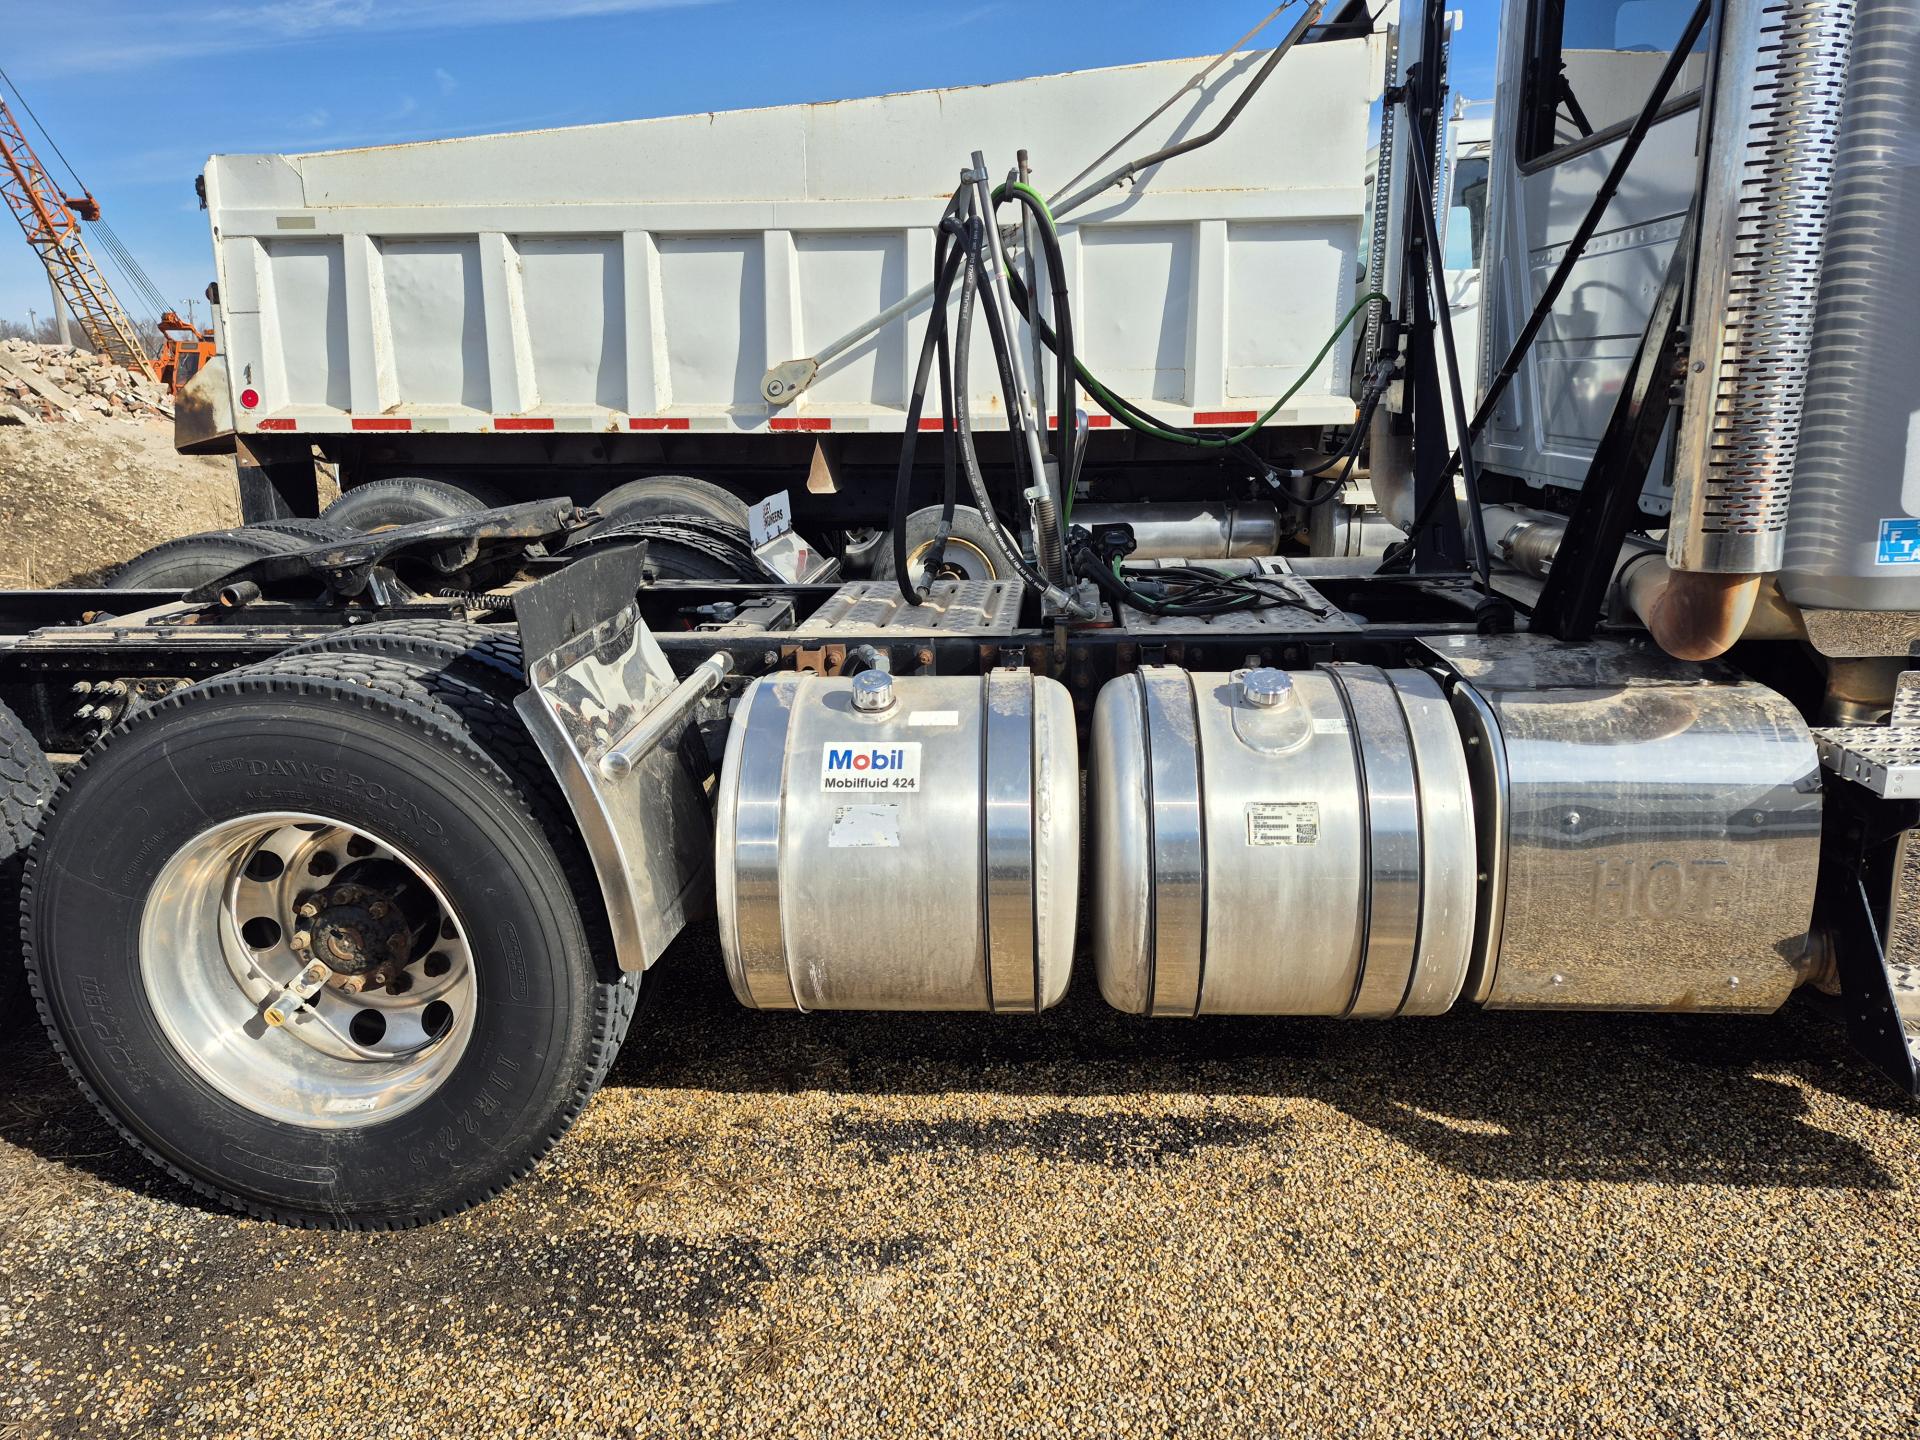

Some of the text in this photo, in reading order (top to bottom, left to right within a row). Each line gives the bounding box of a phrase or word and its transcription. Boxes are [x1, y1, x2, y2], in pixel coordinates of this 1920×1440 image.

[825, 778, 916, 788] Mobilfluid 424
[828, 749, 904, 770] Mobil
[246, 759, 337, 783] DAWG
[346, 772, 443, 836] POUND
[1593, 859, 1729, 920] HOT
[408, 1053, 521, 1171] 11R22.5
